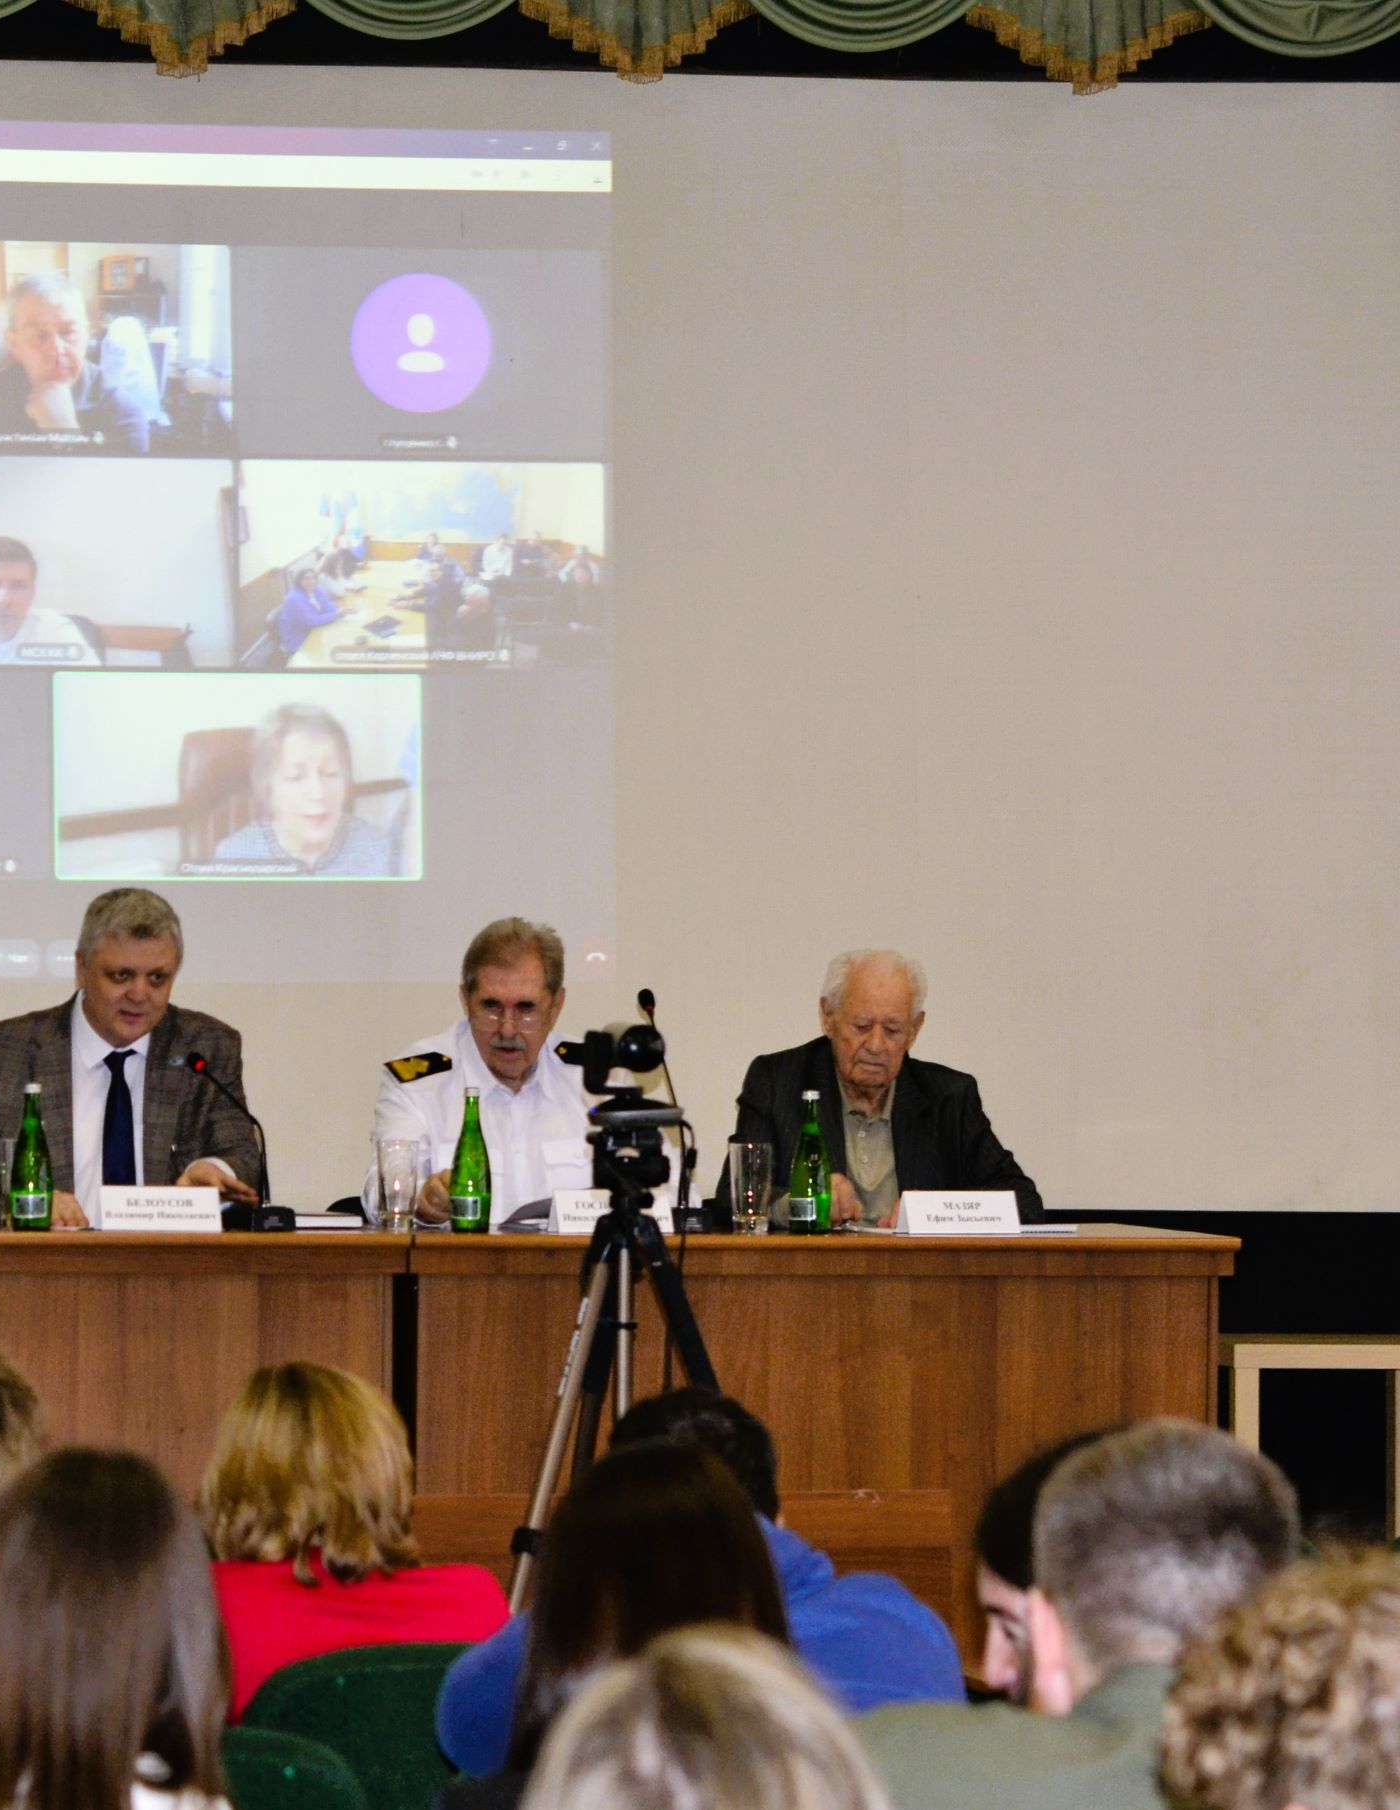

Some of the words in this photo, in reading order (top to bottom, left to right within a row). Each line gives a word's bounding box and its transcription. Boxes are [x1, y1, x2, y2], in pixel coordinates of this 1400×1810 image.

[126, 1198, 194, 1208] БЕЛОУСОВ
[943, 1201, 981, 1210] МАЗЯР
[105, 1211, 154, 1221] Владимир
[156, 1211, 217, 1221] Николаевич
[926, 1214, 954, 1224] Ефим
